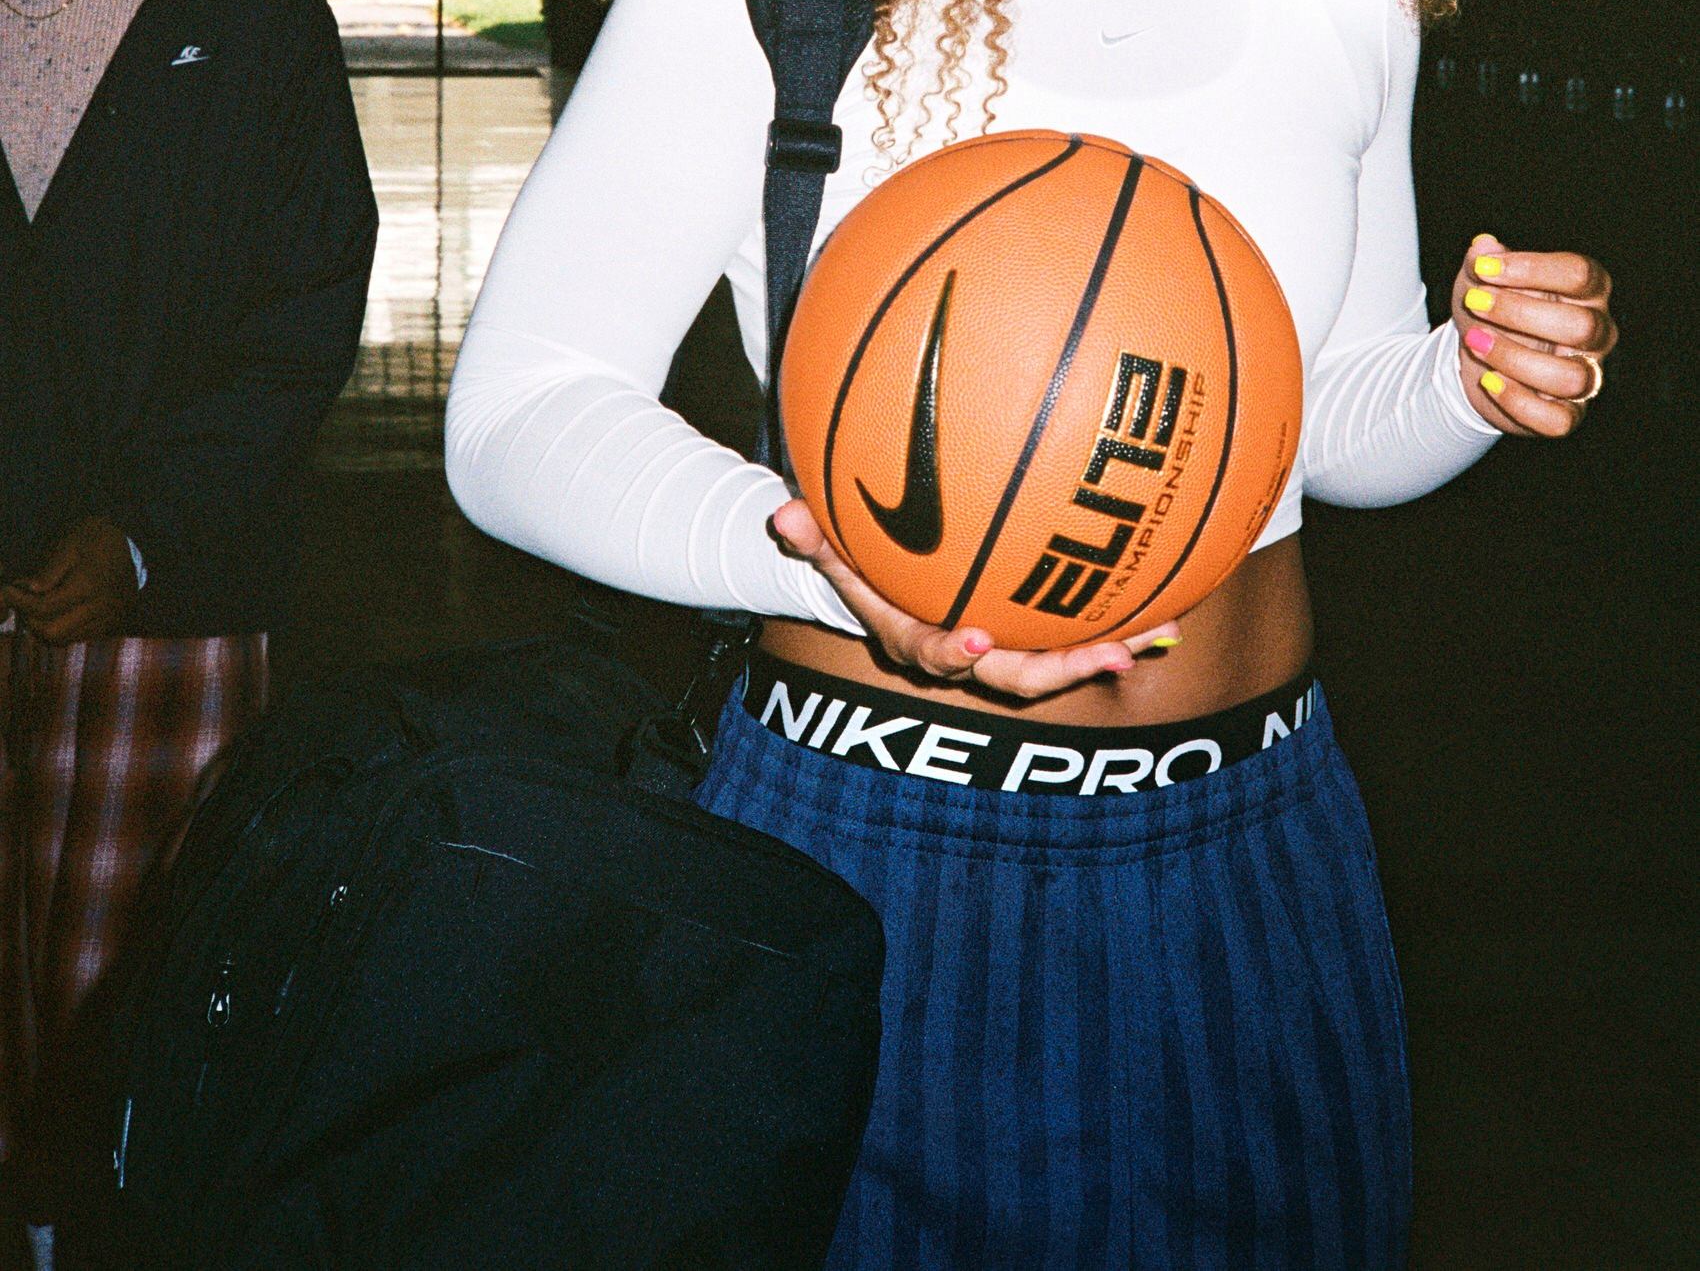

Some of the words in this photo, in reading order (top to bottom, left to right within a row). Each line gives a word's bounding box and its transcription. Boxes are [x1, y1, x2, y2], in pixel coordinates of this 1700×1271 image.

[1008, 351, 1188, 619] ELITE
[1084, 371, 1206, 622] CHAMPIONSHIP
[760, 680, 992, 785] NIKE
[1001, 738, 1222, 796] PRO
[1262, 678, 1316, 750] NI
